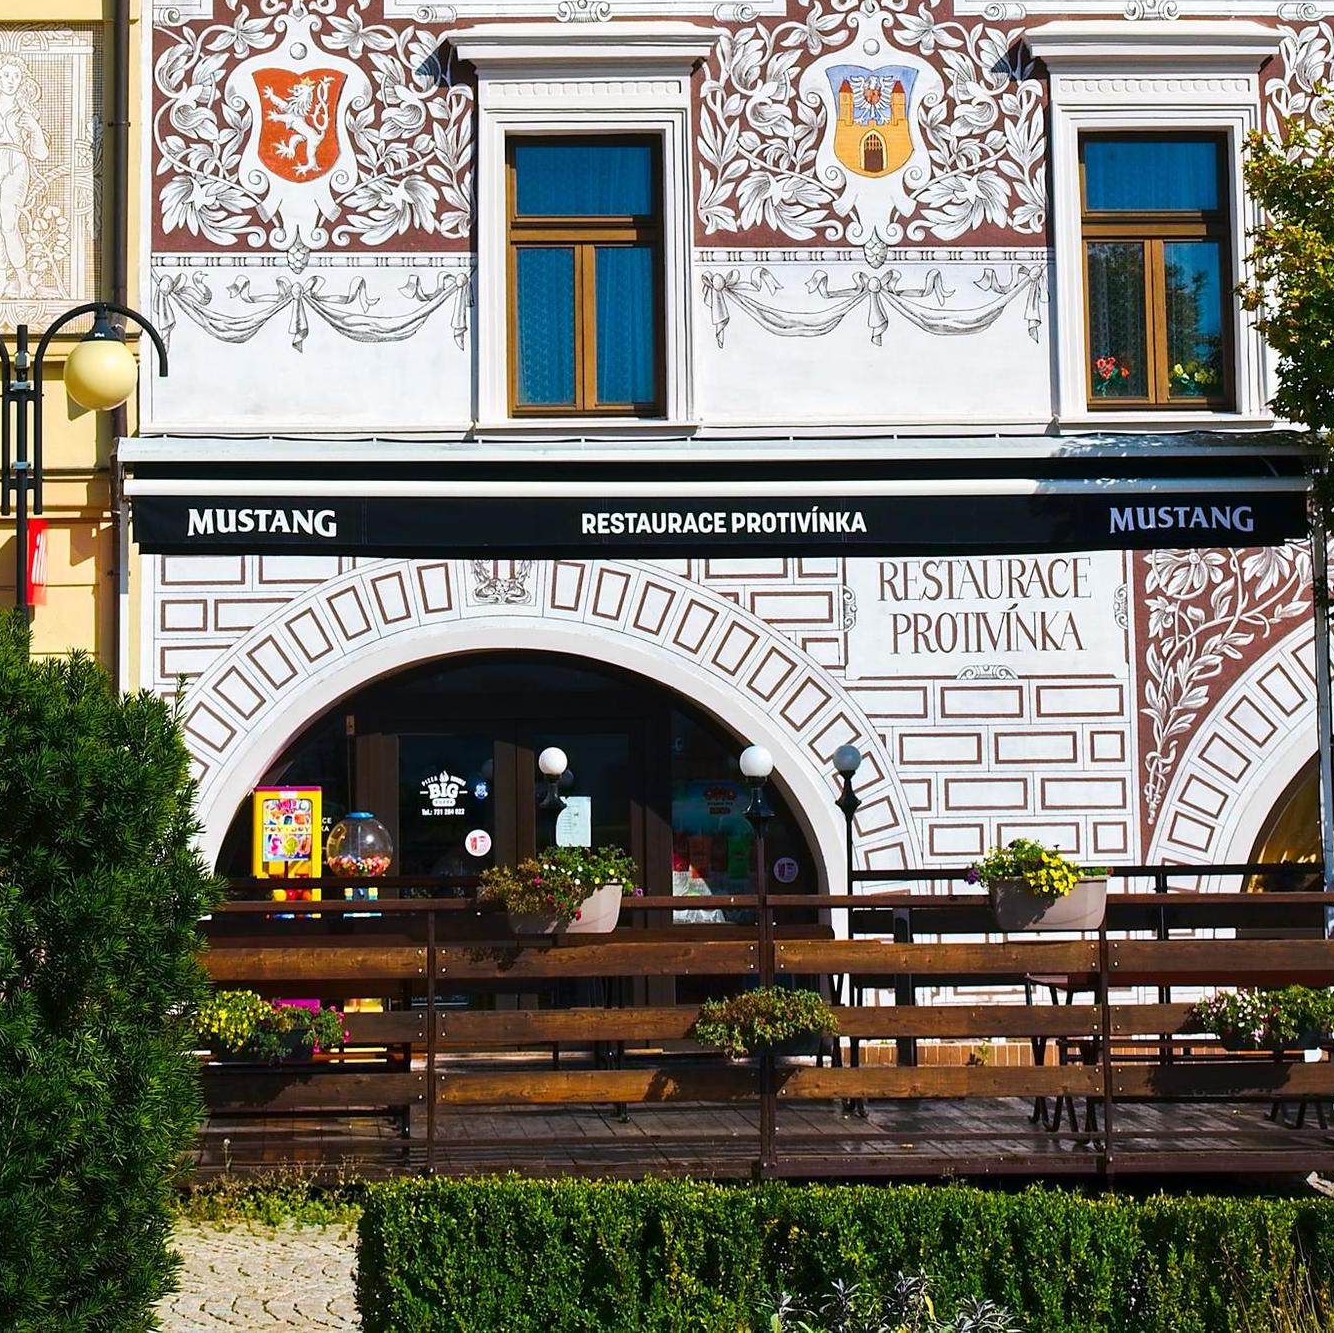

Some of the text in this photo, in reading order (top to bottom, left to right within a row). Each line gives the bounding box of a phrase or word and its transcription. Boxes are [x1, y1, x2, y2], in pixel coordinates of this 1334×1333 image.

[187, 508, 337, 537] MUSTANG
[581, 506, 867, 534] RESTAURACE PROTIVÍNKA
[1109, 506, 1254, 534] MUSTANG
[877, 557, 1092, 602] RESTAURACE
[889, 603, 1087, 655] PROTIVÍNKA
[428, 782, 459, 799] BIG
